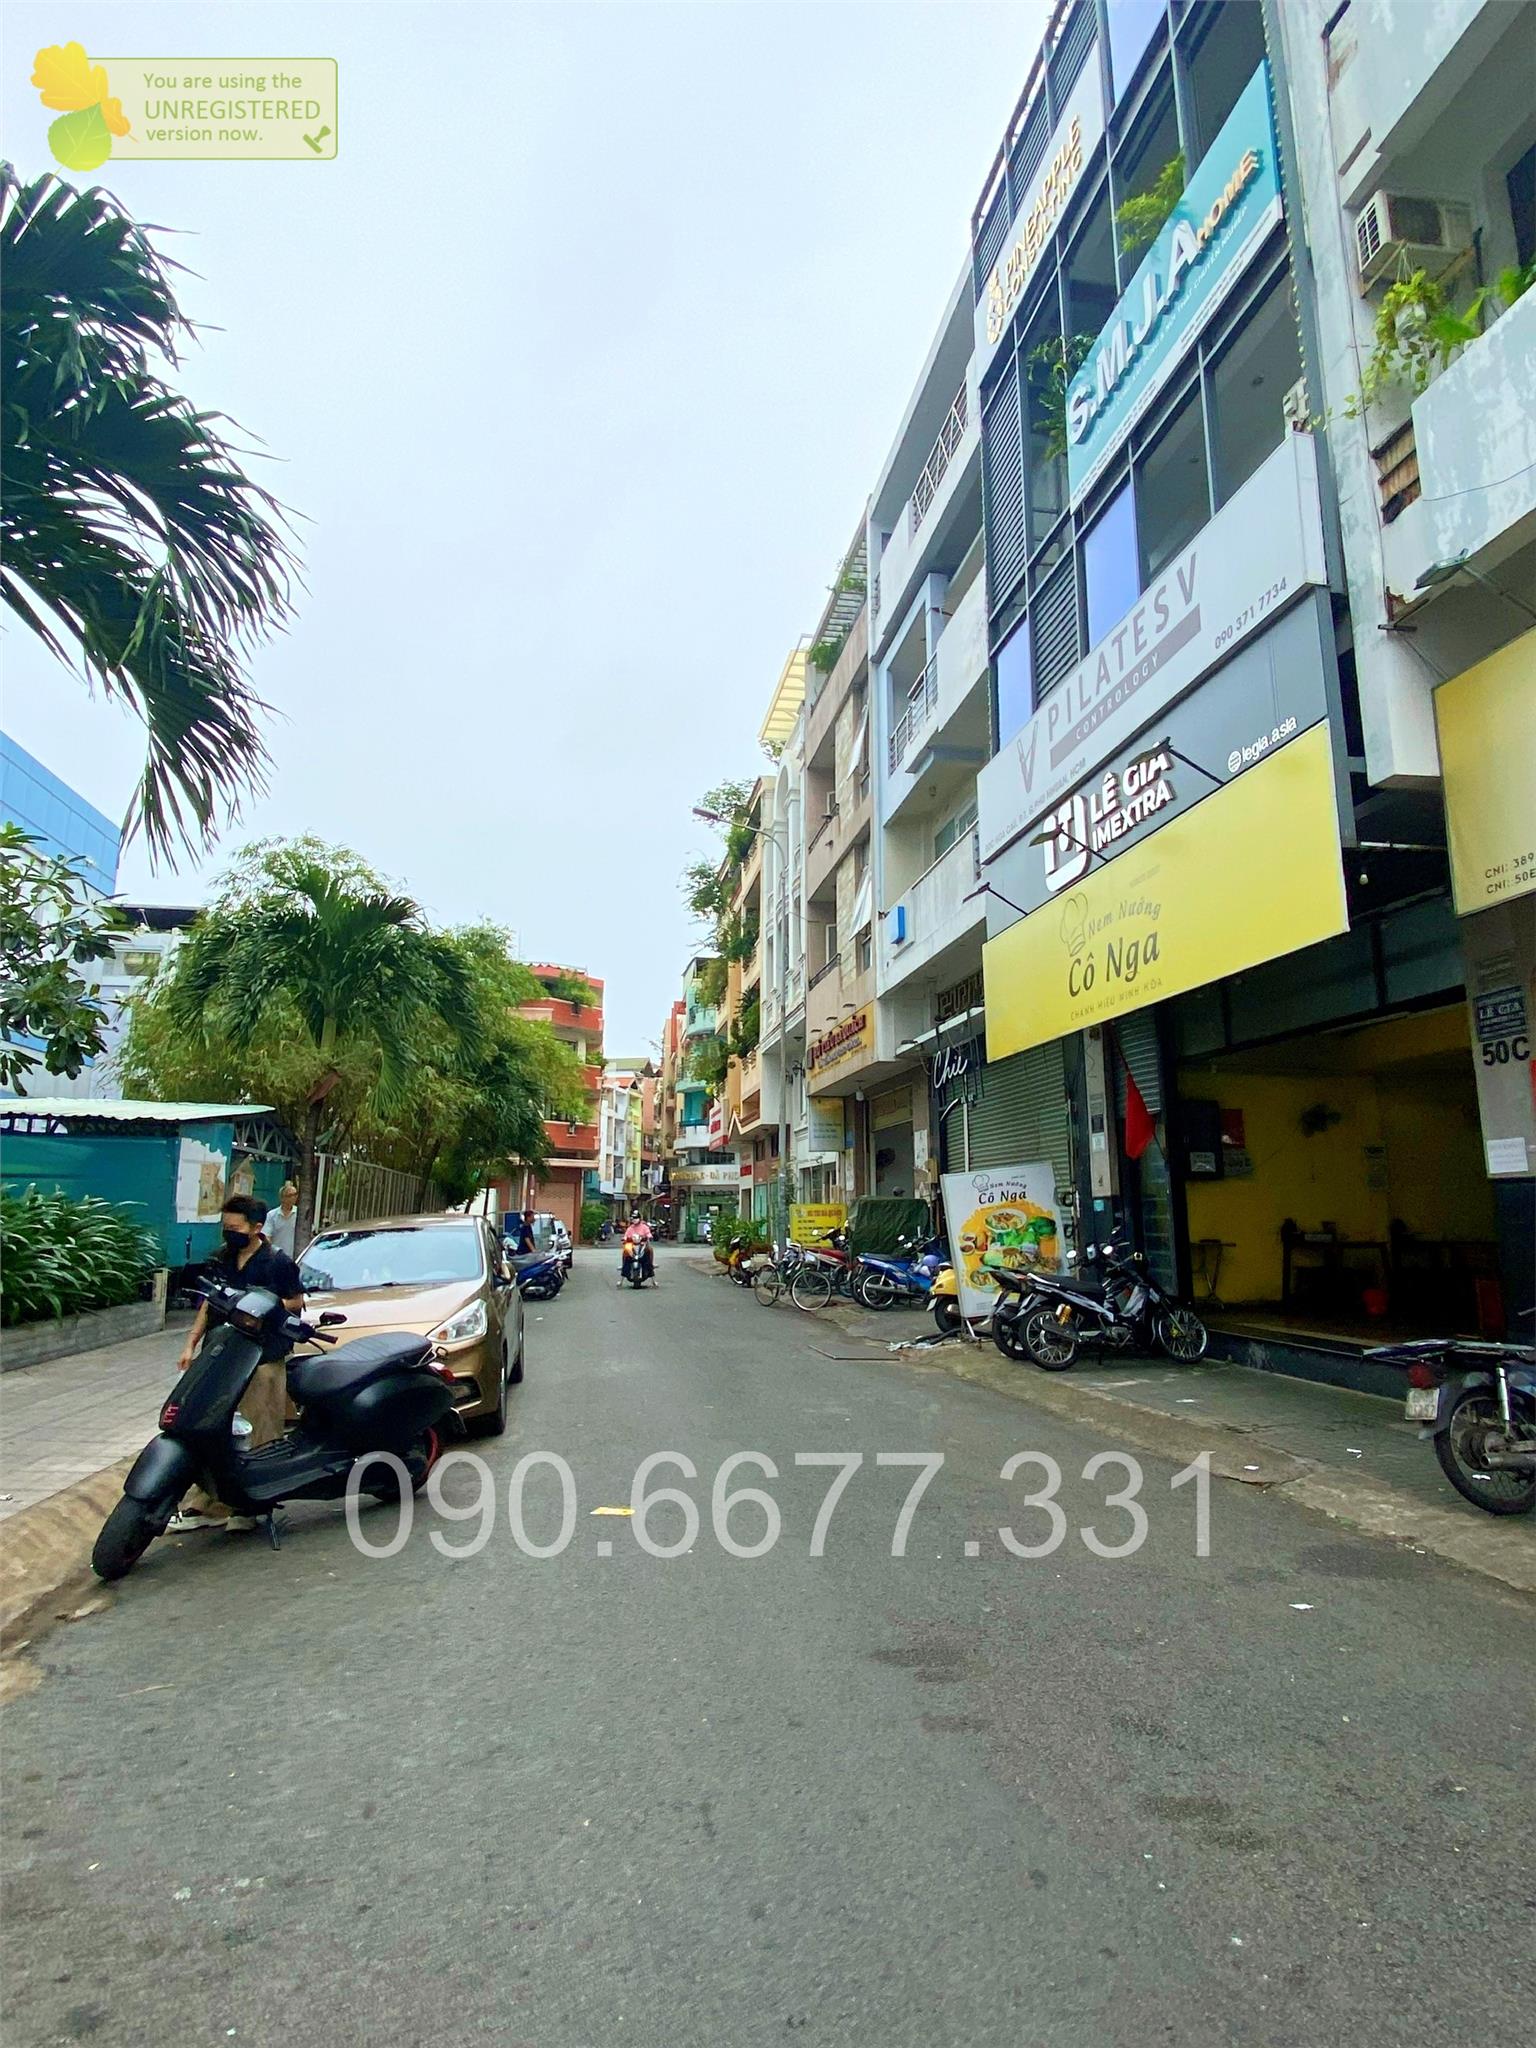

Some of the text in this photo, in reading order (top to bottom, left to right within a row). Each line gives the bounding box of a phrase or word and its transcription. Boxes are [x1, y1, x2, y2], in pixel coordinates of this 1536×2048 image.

[1005, 114, 1080, 287] PINEAPPLE
[1005, 145, 1082, 312] CONSULTING
[1214, 576, 1287, 650] 090 371 7734
[1075, 651, 1160, 741] CONTROLOGY
[1241, 716, 1298, 764] legia.asia
[1090, 771, 1118, 825] LÊ
[1122, 742, 1171, 797] GIA
[1091, 778, 1173, 853] IMEXTRA
[1088, 911, 1113, 940] Nem
[1069, 931, 1160, 997] Cô Nga
[1482, 1036, 1531, 1067] 50C
[978, 1190, 1028, 1205] Cô Nga
